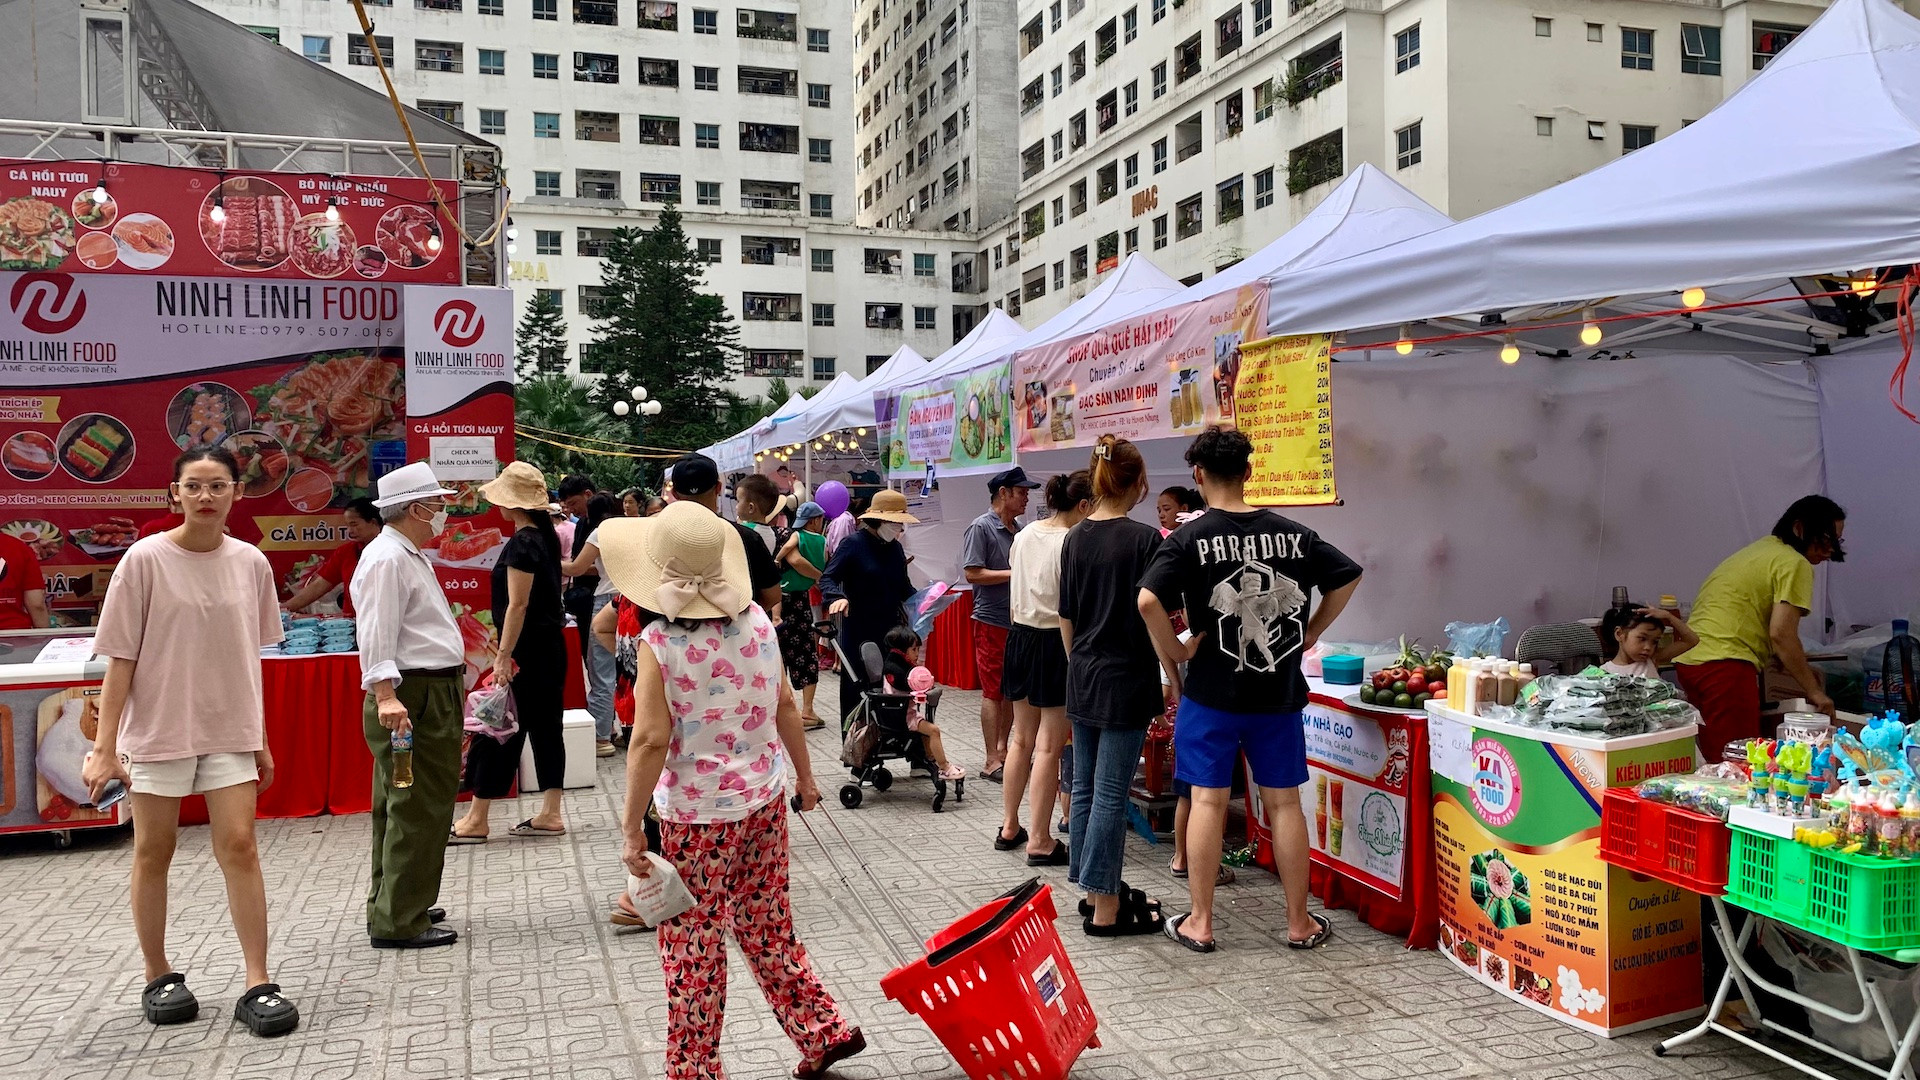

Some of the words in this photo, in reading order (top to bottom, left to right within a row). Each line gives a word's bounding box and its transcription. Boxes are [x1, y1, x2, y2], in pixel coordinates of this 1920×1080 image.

[31, 187, 67, 198] NAUY
[156, 281, 233, 317] NINH
[244, 284, 311, 319] LINH
[323, 286, 398, 321] FOOD
[29, 341, 68, 362] LINH
[73, 342, 116, 362] FOOD
[415, 351, 443, 367] NINH
[446, 352, 472, 368] LINH
[475, 353, 505, 368] FOOD
[1114, 387, 1134, 403] NAM
[414, 422, 429, 434] CÁ
[432, 421, 450, 434] HỒI
[453, 423, 475, 434] TƯƠI
[478, 425, 504, 434] NAUY
[45, 495, 66, 504] NEM
[69, 495, 97, 504] CHUA
[270, 524, 297, 542] CÁ
[302, 519, 334, 542] HỒI
[1196, 533, 1304, 566] PARADOX
[445, 579, 459, 589] SÒ
[462, 578, 479, 589] ĐỎ
[1313, 715, 1331, 733] NHÀ
[1333, 722, 1353, 740] GẠO
[1568, 750, 1602, 790] New
[1644, 760, 1665, 779] ANH
[1668, 755, 1692, 774] FOOD
[1480, 786, 1505, 806] FOOD
[1569, 889, 1580, 900] BA
[1570, 902, 1575, 911] 7
[1577, 904, 1598, 917] PHÚT
[1580, 945, 1596, 957] QUE
